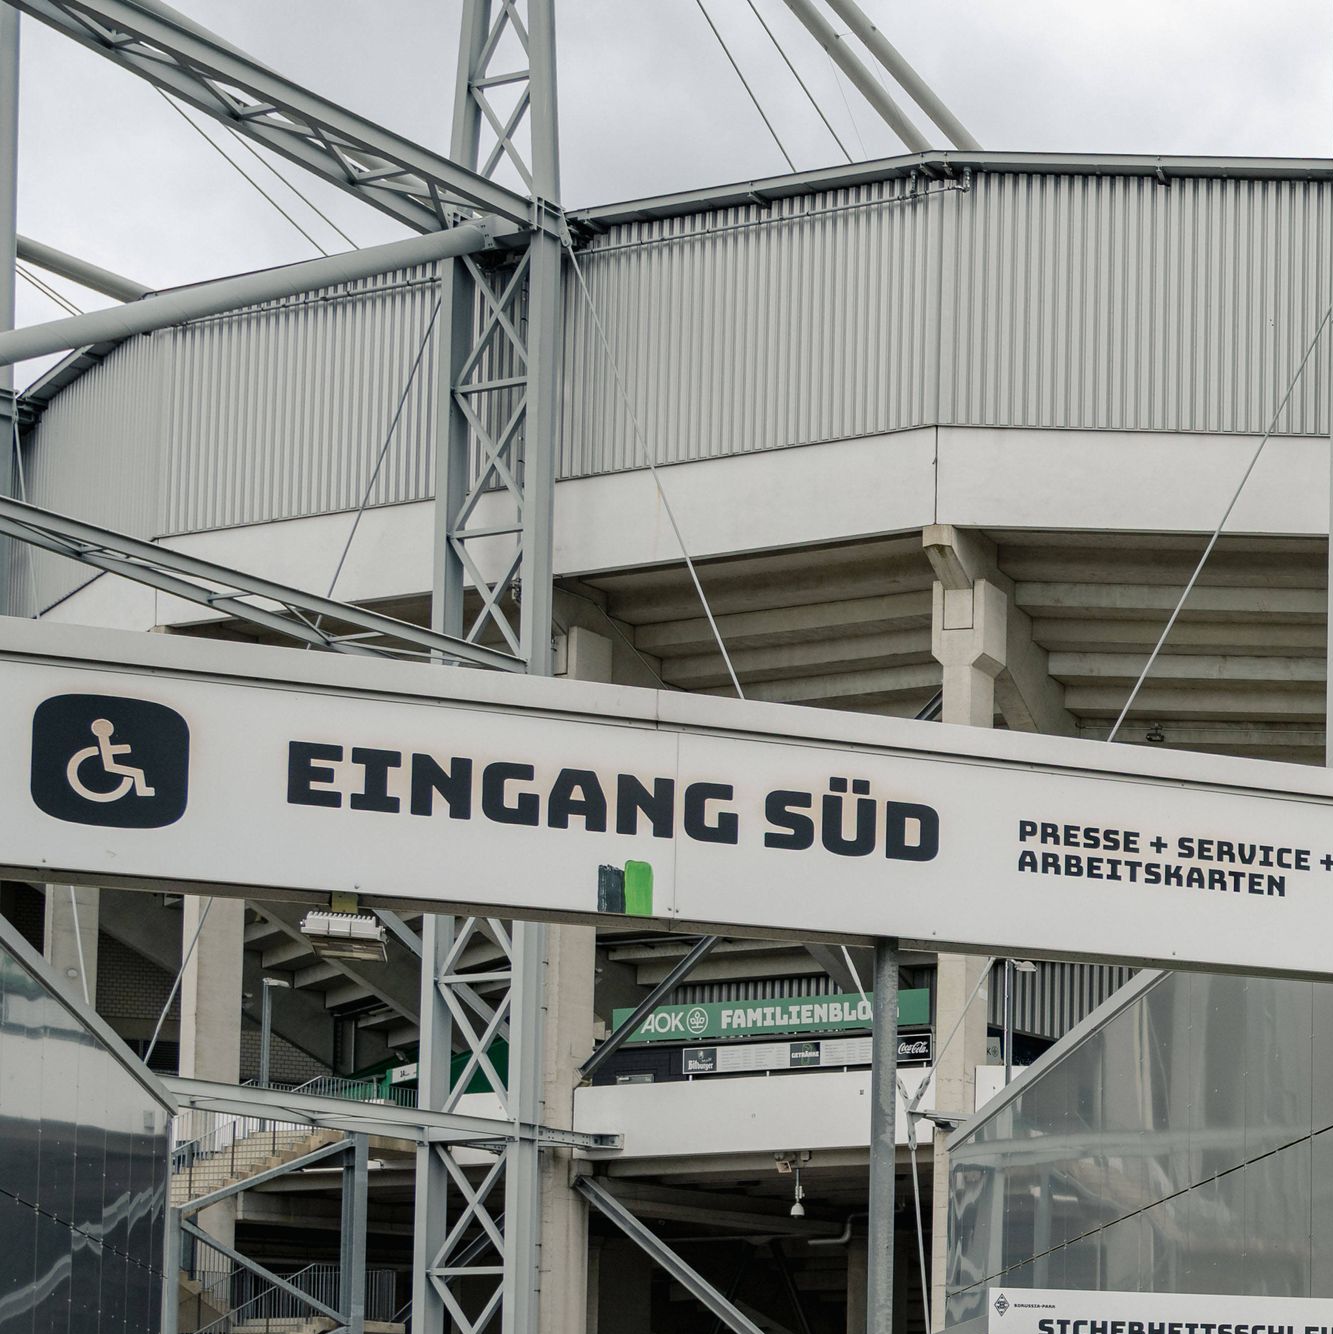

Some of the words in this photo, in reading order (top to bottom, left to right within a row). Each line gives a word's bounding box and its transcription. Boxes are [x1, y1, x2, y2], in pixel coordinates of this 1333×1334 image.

[287, 740, 739, 846] EINGANG
[764, 776, 941, 863] SÜD
[1018, 819, 1141, 854] PRESSE
[1149, 835, 1168, 855] +
[1177, 836, 1312, 872] SERVICE
[1017, 849, 1286, 898] ARBEITSKARTEN
[640, 1012, 685, 1034] AOK
[721, 1000, 900, 1030] FAMILIENBLO
